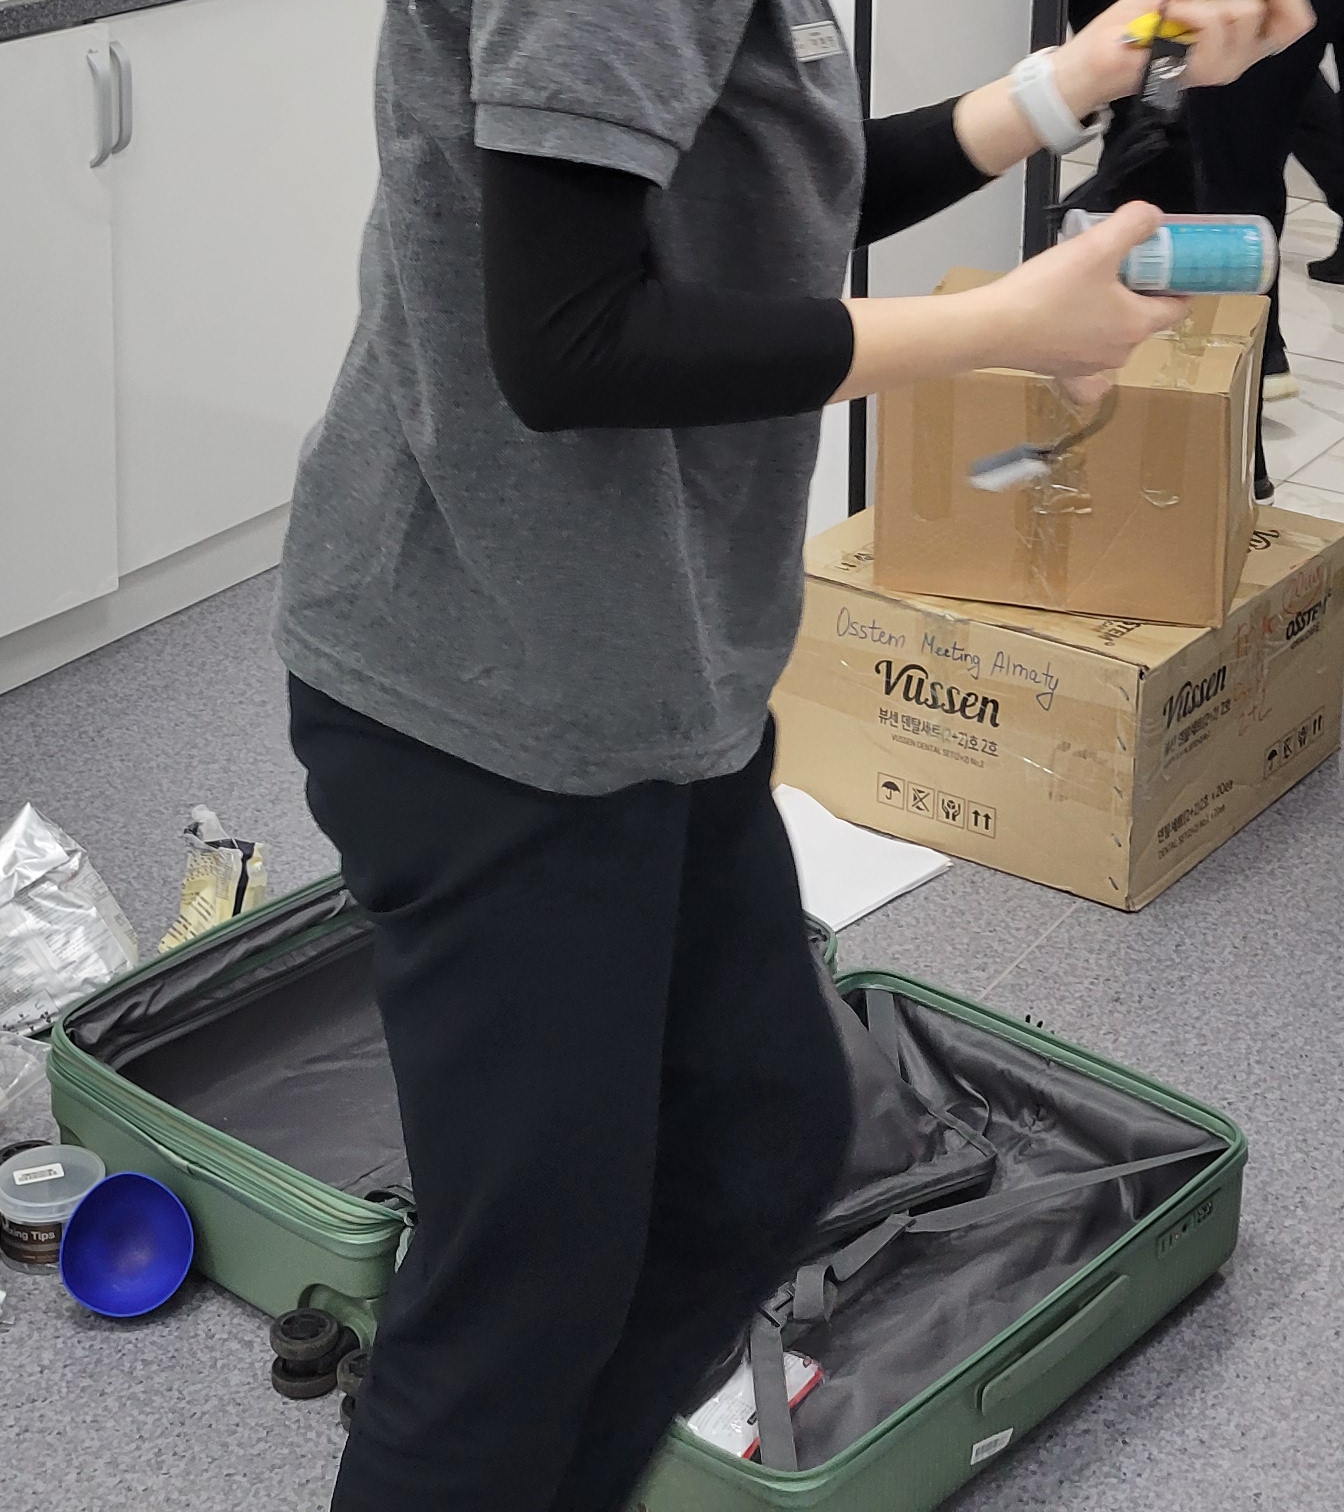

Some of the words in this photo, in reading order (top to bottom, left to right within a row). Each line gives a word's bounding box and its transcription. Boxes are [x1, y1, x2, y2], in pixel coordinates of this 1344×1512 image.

[837, 607, 906, 648] Osstem
[920, 632, 981, 679] Meeting
[990, 651, 1059, 711] Almaty
[875, 659, 1000, 728] Vussen
[31, 1231, 56, 1242] Tips
